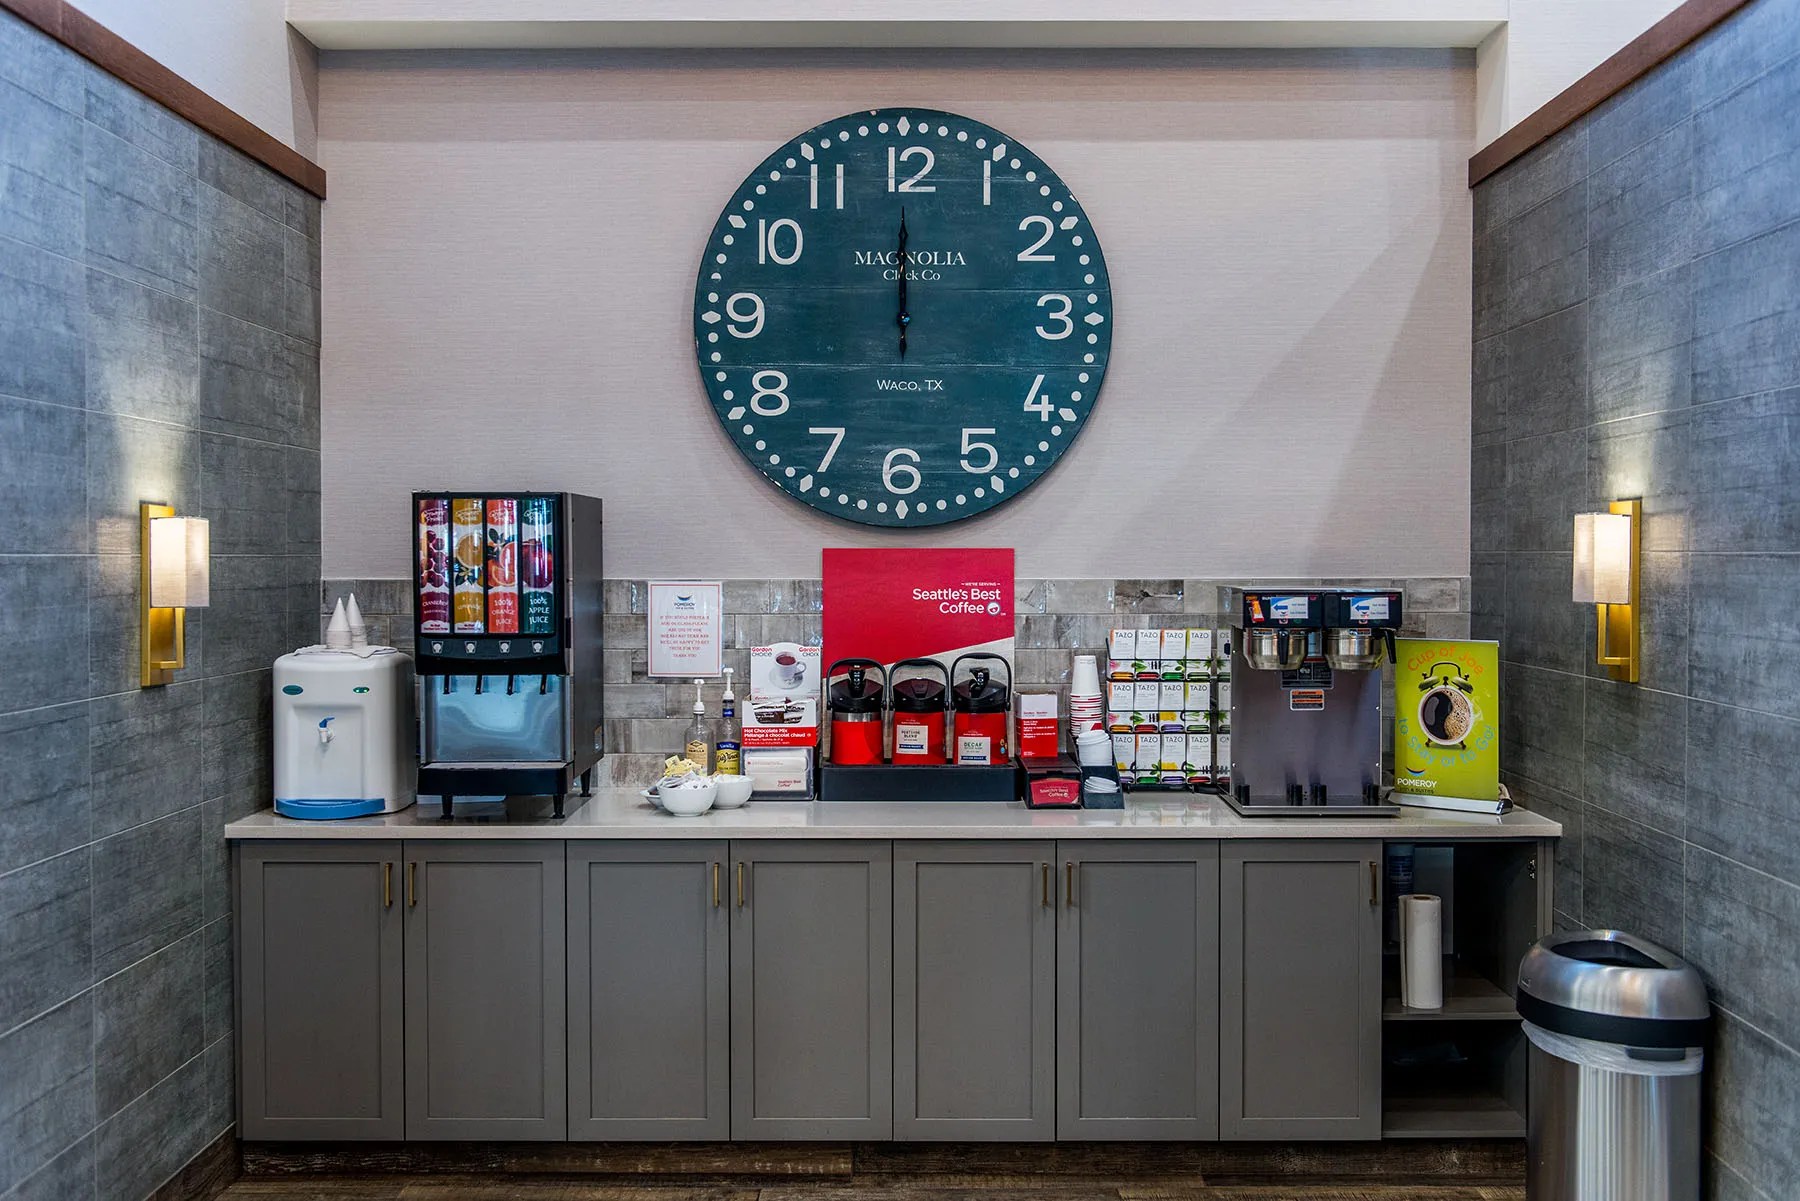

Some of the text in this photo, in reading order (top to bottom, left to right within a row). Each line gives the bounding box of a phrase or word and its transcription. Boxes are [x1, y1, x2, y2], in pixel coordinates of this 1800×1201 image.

[888, 146, 936, 193] 12
[810, 164, 844, 209] 11
[983, 160, 991, 205] 1
[758, 218, 804, 265] 10
[1017, 216, 1056, 262] 2
[854, 251, 967, 266] MAGNOLIA
[883, 269, 941, 281] Clck Co
[726, 292, 766, 339] 9
[1035, 294, 1073, 340] 3
[924, 379, 943, 391] TX
[750, 370, 790, 416] 8
[1023, 374, 1054, 422] 4
[808, 427, 846, 472] 7
[960, 427, 998, 473] 5
[882, 448, 921, 494] 6
[529, 595, 547, 605] 100%
[912, 588, 1001, 600] Seattle's Best
[939, 602, 984, 614] Coffee
[529, 616, 548, 625] JUICE
[1115, 631, 1134, 639] TAZO
[1140, 631, 1159, 639] TAZO
[1166, 631, 1184, 640] TAZO
[1191, 632, 1209, 640] TAZO
[1407, 645, 1484, 676] Cup of Joe
[1113, 684, 1132, 692] TAZO
[1138, 684, 1157, 692] TAZO
[1164, 684, 1183, 692] TAZO
[1115, 736, 1133, 744] TAZO
[1140, 736, 1158, 744] TAZO
[1166, 736, 1184, 744] TAZO
[1191, 736, 1210, 744] TAZO
[1398, 717, 1409, 735] to
[1407, 735, 1437, 765] Stay
[1441, 758, 1456, 767] or
[1460, 749, 1476, 764] to
[1397, 778, 1438, 788] POMEROY
